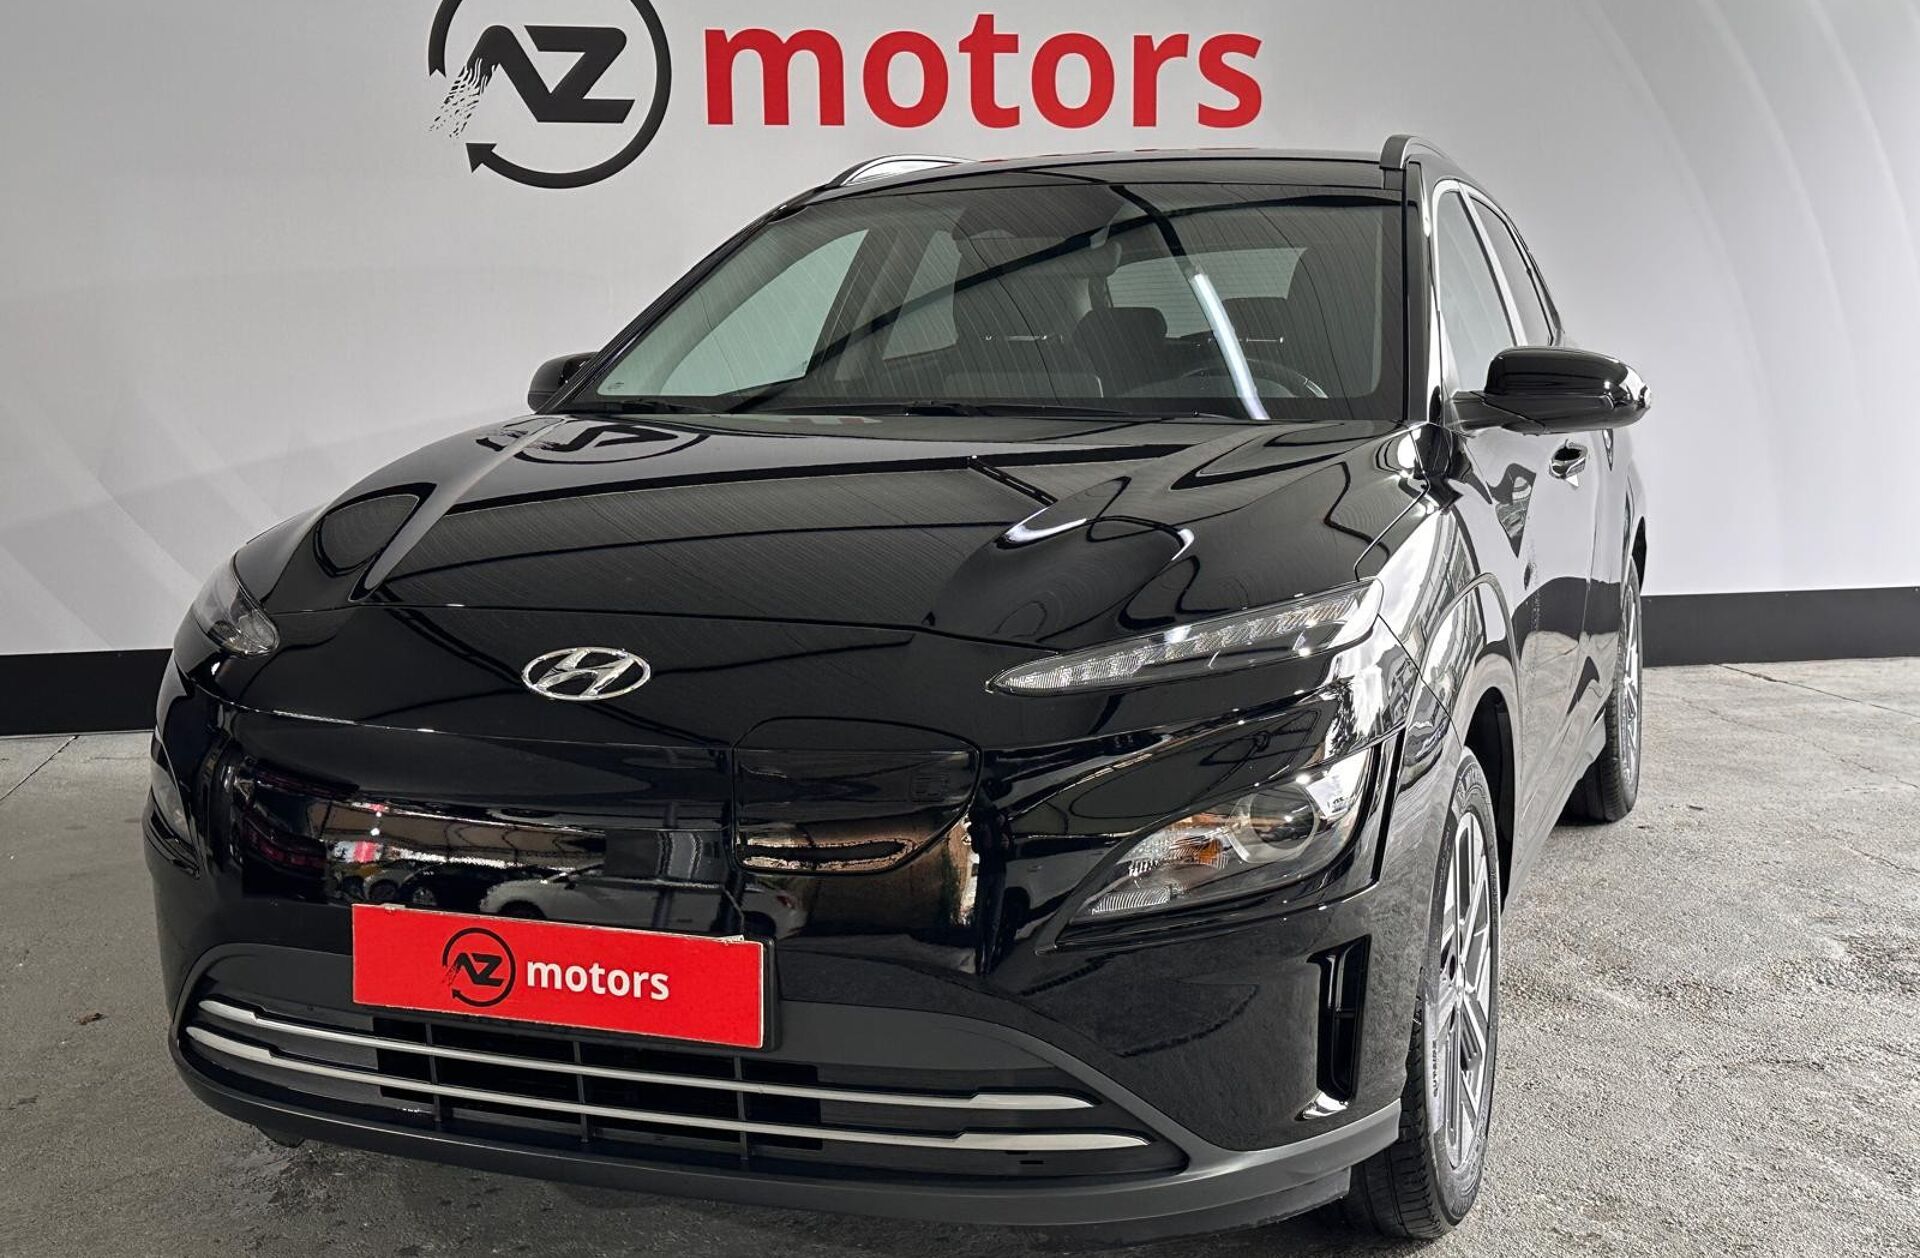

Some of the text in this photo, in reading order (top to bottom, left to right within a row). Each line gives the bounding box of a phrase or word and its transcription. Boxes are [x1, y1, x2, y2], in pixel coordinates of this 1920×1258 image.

[430, 14, 1261, 135] AZ motors
[444, 953, 669, 1001] AZ motors
